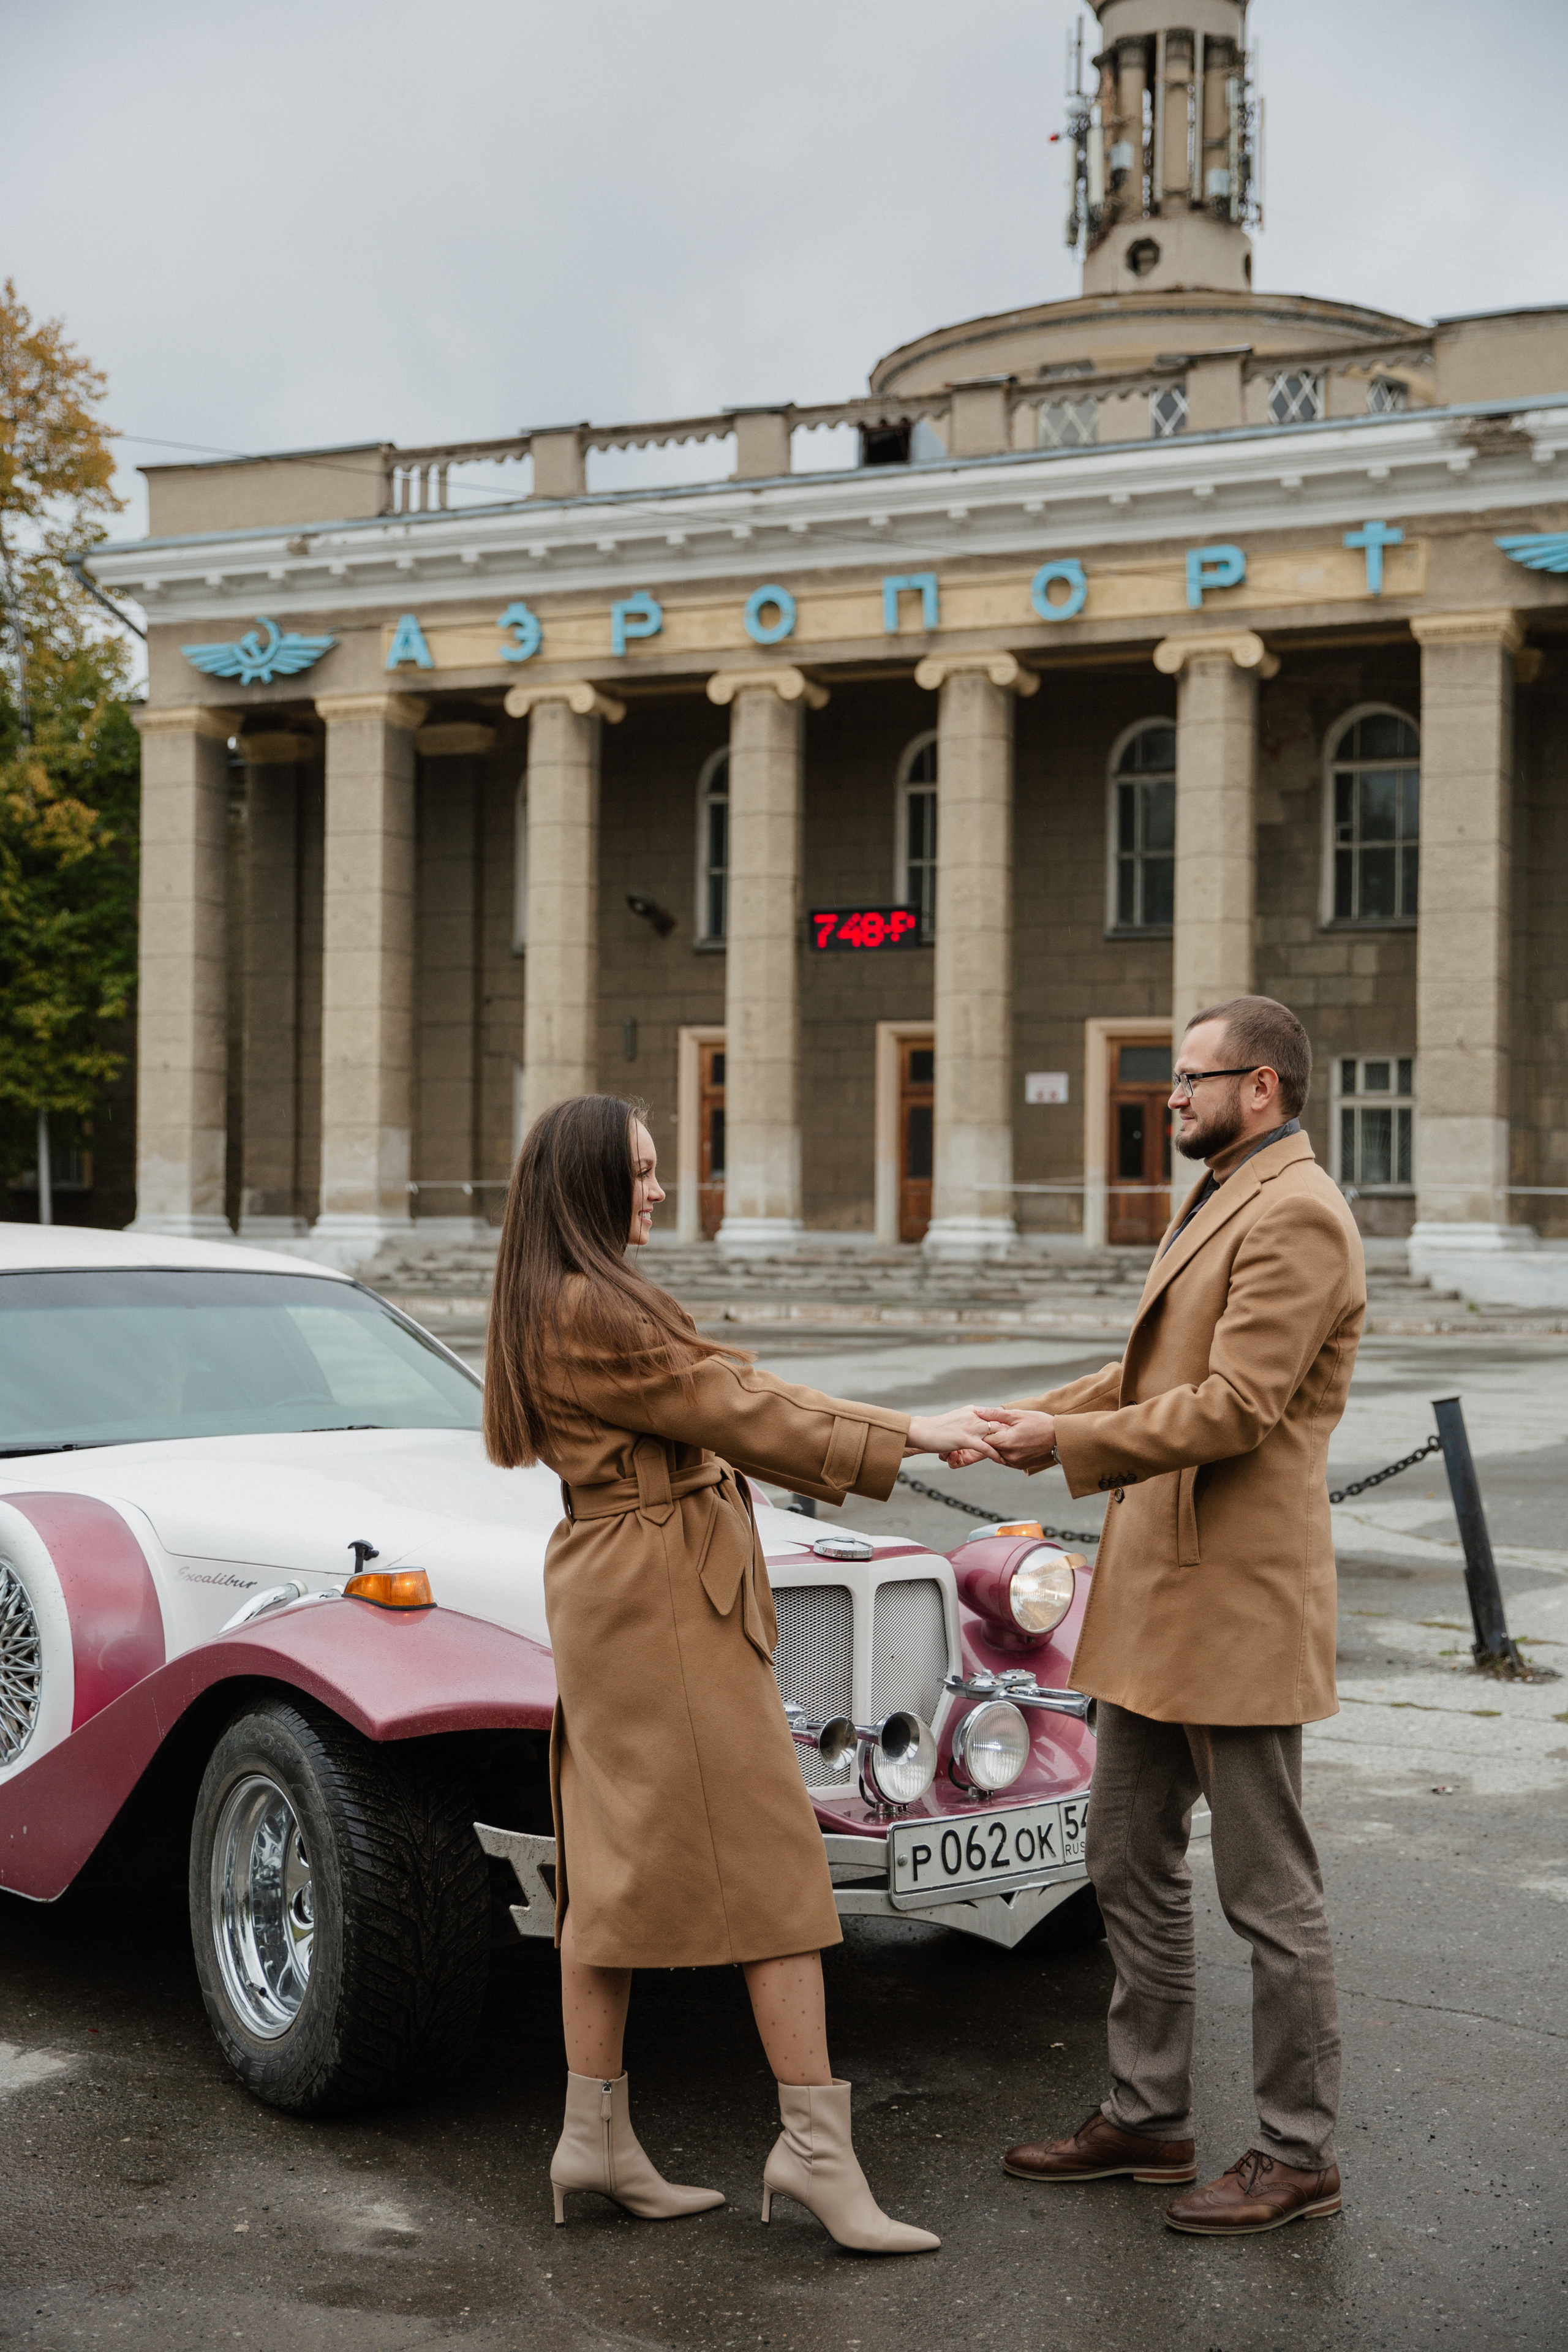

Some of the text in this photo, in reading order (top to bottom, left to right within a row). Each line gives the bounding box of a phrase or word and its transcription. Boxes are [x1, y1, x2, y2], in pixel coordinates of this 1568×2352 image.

[385, 521, 1405, 671] АЭРОПОРТ
[178, 1566, 257, 1589] Excalibur
[1065, 1841, 1085, 1856] RUS
